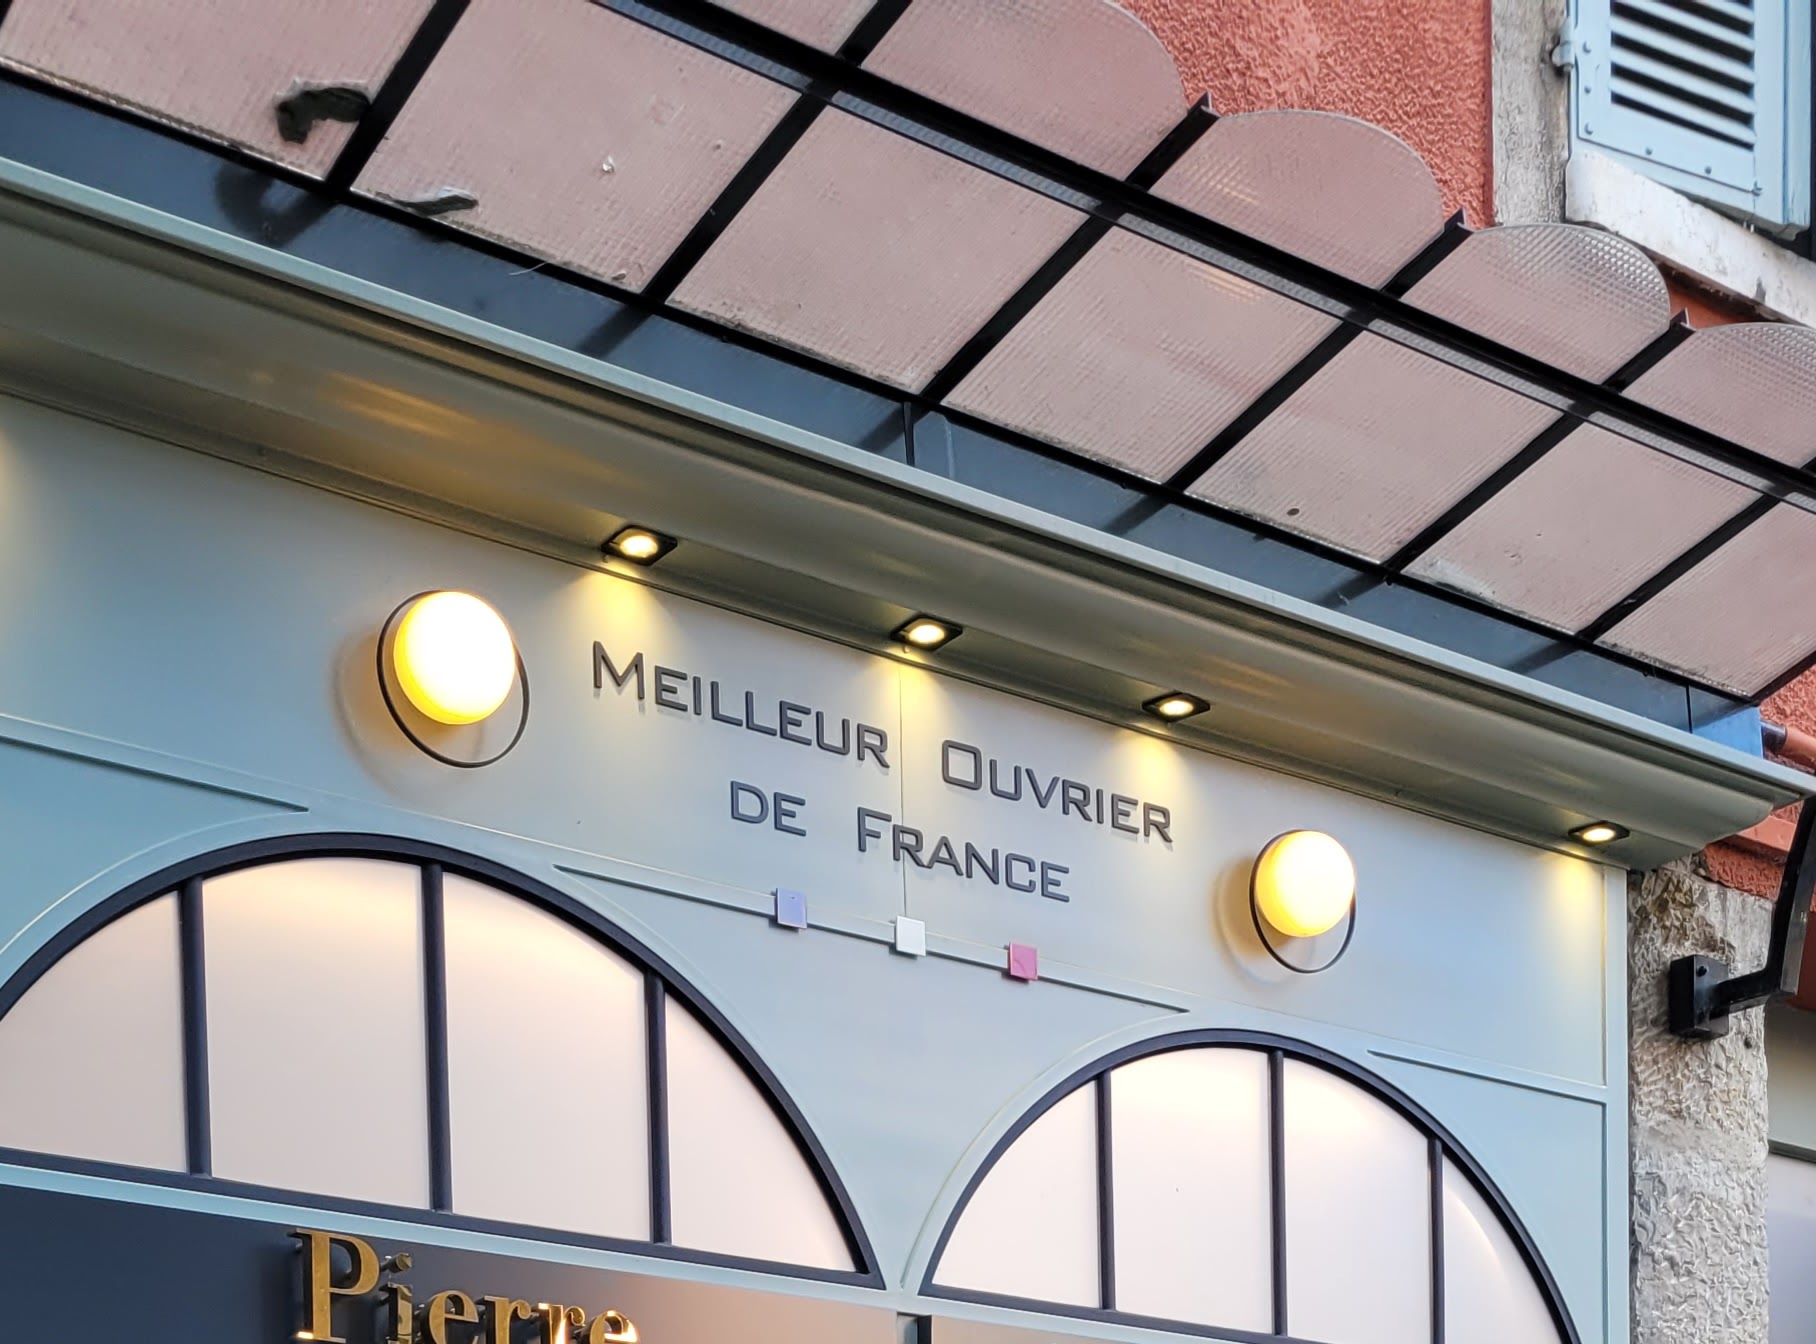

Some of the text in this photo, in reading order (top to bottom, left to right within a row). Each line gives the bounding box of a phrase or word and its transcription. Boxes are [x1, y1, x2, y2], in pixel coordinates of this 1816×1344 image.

[593, 641, 1173, 842] MEILLEUR OUVRIER
[731, 781, 1069, 901] DE FRANCE
